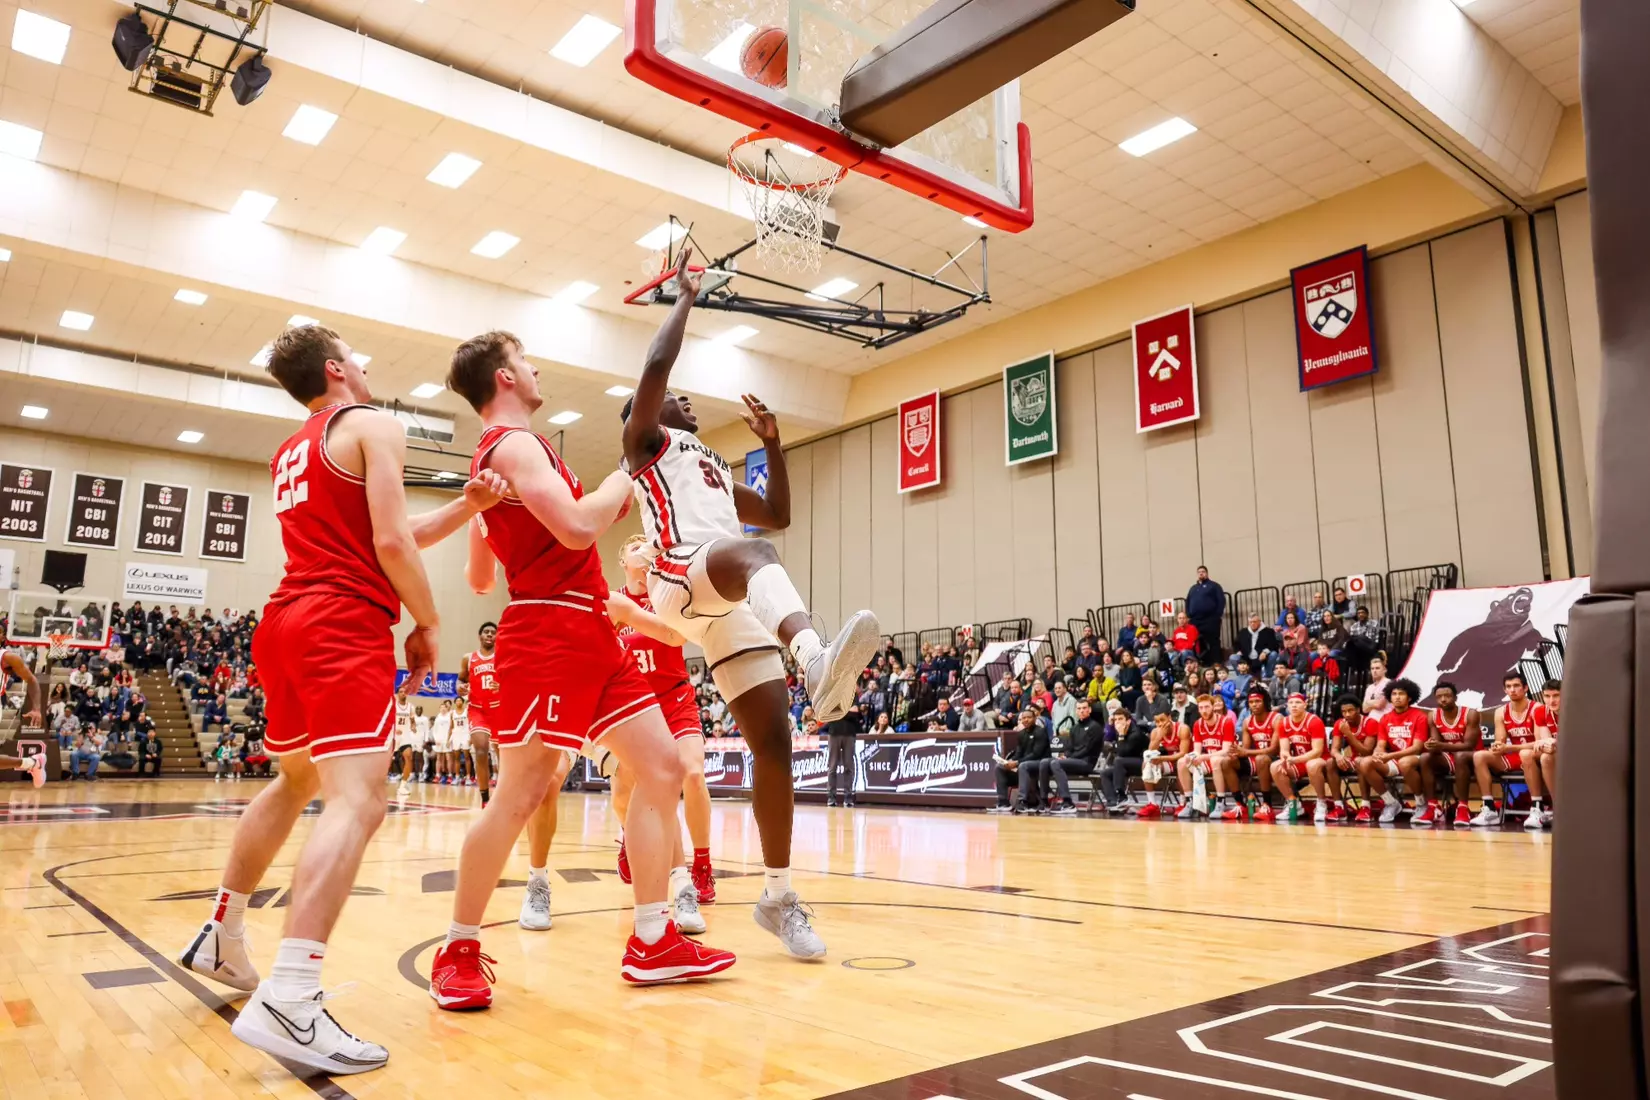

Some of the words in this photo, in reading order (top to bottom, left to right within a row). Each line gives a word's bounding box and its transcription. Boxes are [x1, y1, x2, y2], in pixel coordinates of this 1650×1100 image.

[1304, 346, 1368, 372] Pennsylvania
[1150, 397, 1183, 415] Harvard
[1012, 430, 1048, 448] Dartmouth
[274, 439, 310, 514] 22
[908, 463, 929, 476] Cornell
[10, 499, 33, 513] NIT
[84, 508, 106, 521] CBI
[1, 517, 37, 532] 2003
[153, 516, 172, 528] CIT
[216, 523, 236, 535] CBI
[76, 526, 110, 539] 2008
[145, 532, 175, 546] 2014
[210, 540, 238, 552] 2019
[146, 572, 188, 580] LEXUS
[166, 586, 203, 595] WARWICK
[1350, 578, 1365, 592] O
[1162, 602, 1173, 614] N
[632, 649, 656, 674] 31
[547, 694, 560, 722] C
[870, 762, 890, 770] SINCE
[890, 738, 968, 793] Narragansett
[970, 762, 990, 771] 1890
